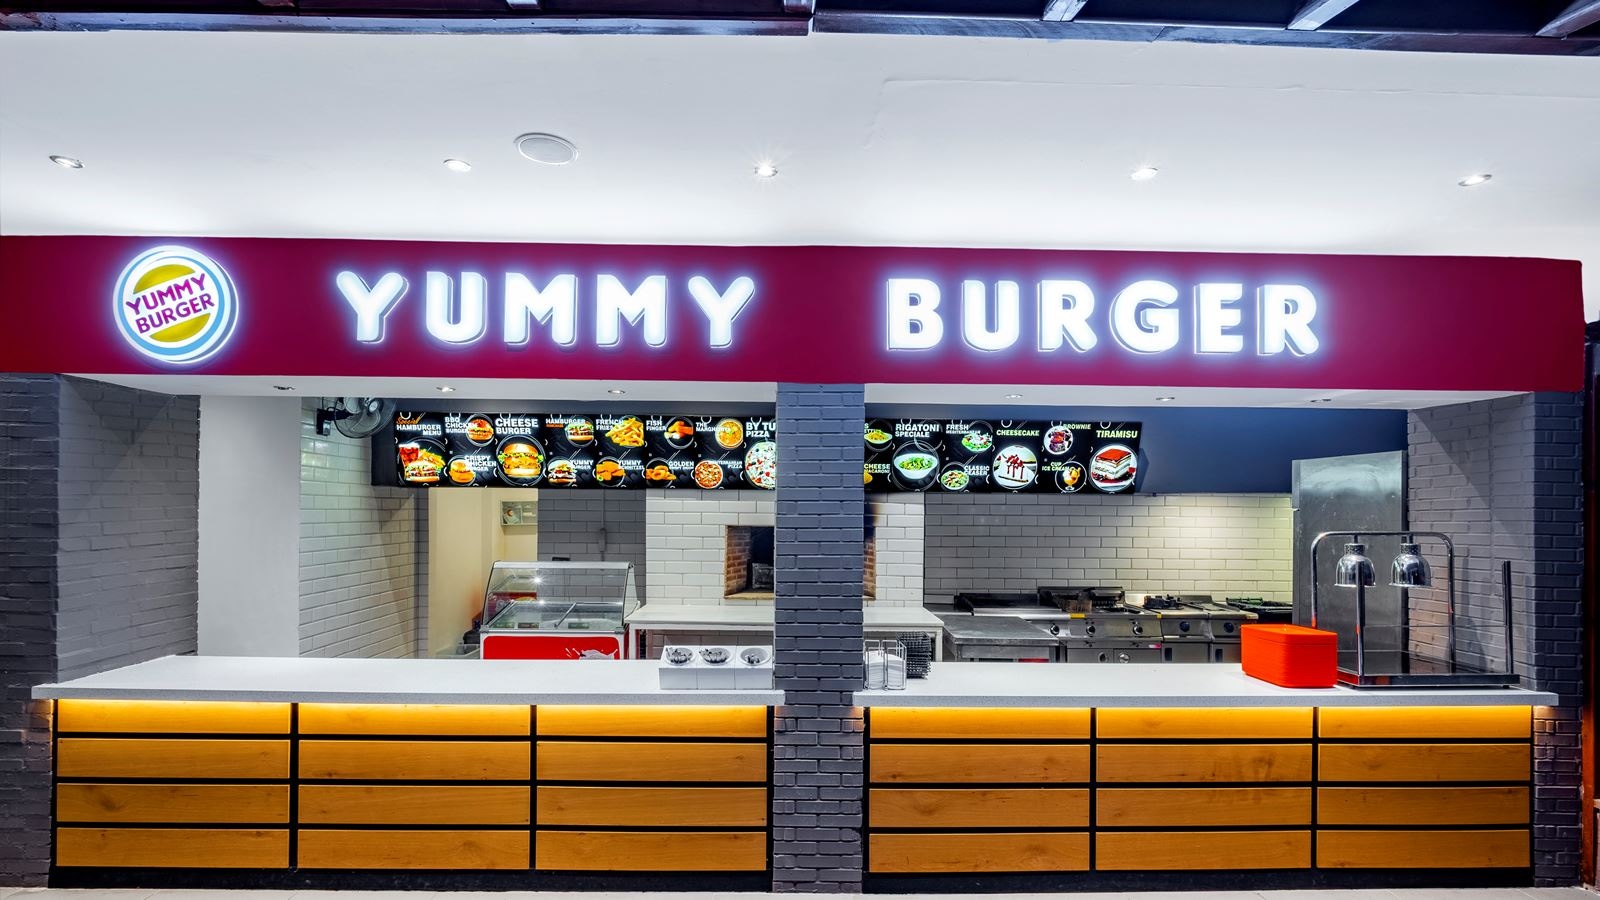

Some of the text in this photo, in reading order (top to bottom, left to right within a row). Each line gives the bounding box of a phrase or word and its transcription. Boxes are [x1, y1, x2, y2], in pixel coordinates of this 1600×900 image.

[126, 273, 205, 316] YUMMY
[135, 293, 215, 334] BURGER
[336, 270, 1320, 355] YUMMY BURGER
[495, 418, 539, 428] CHEESE
[746, 422, 761, 430] BY
[895, 424, 940, 432] RIGATONI
[1096, 430, 1138, 438] TIRAMISU
